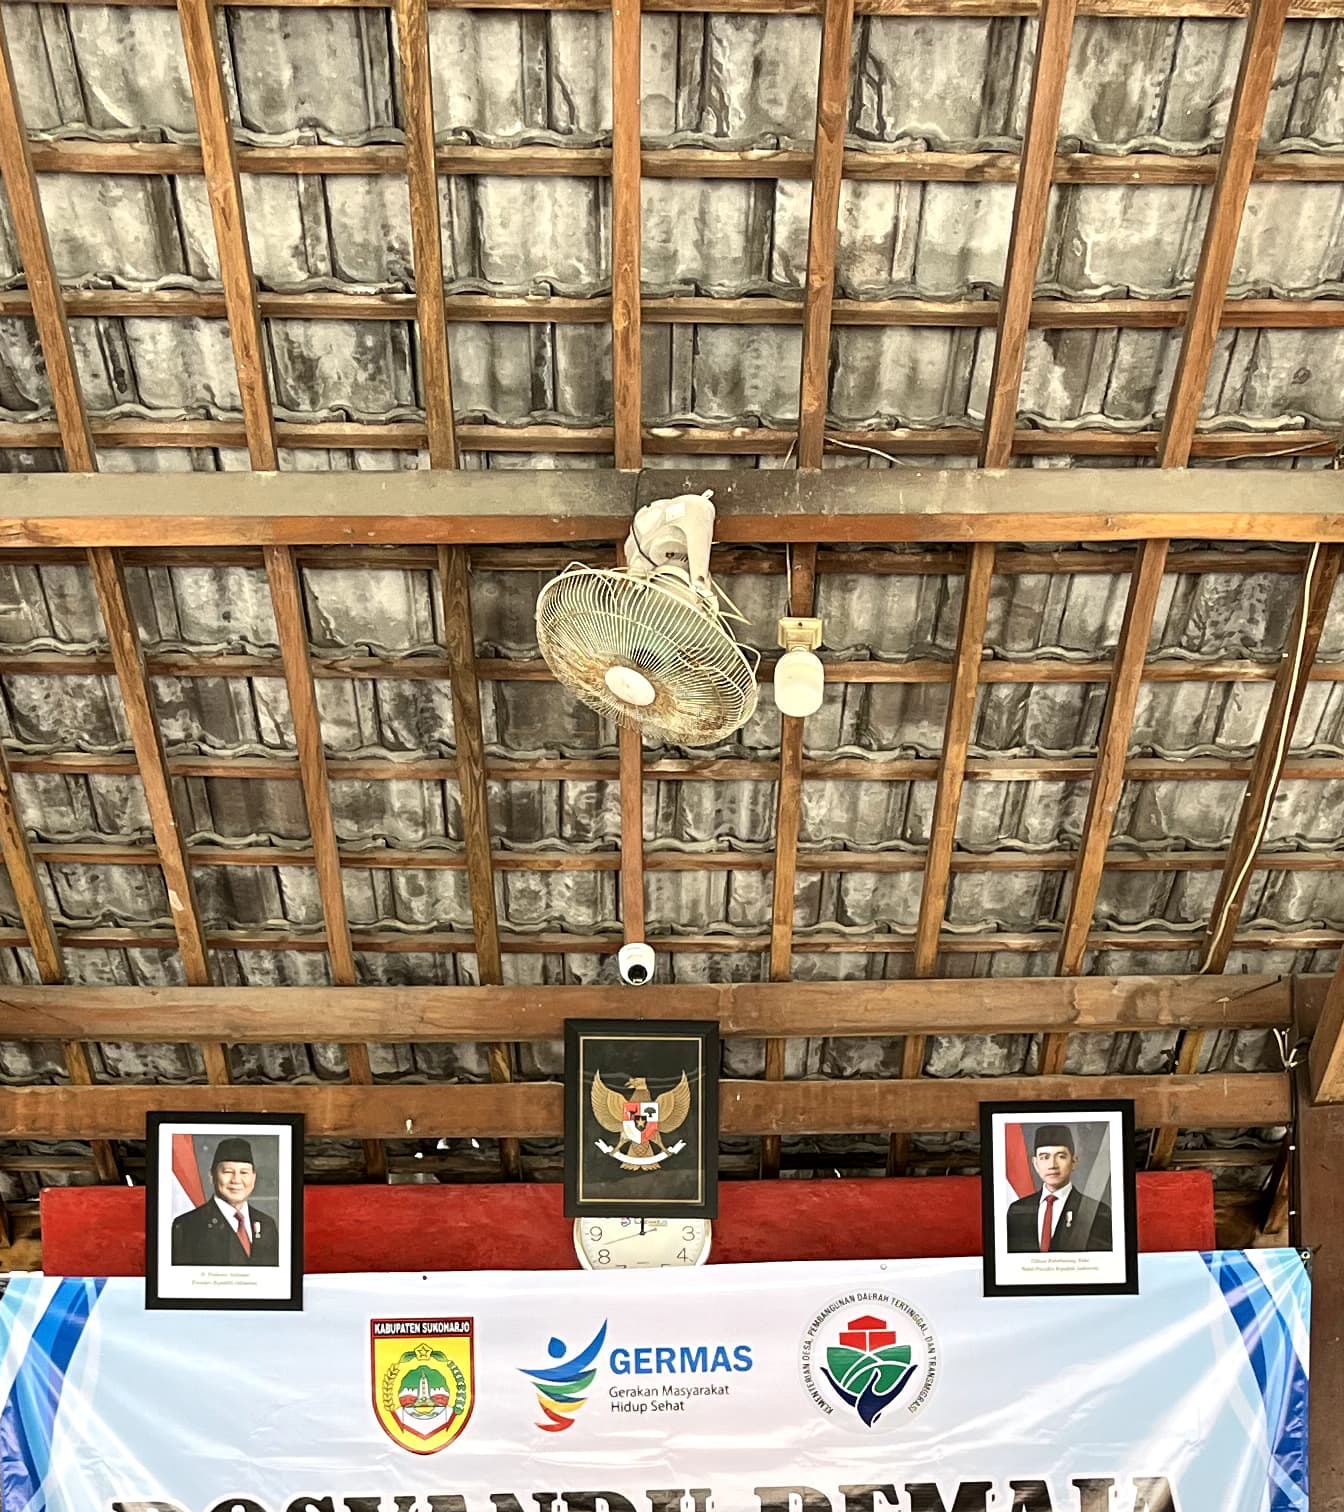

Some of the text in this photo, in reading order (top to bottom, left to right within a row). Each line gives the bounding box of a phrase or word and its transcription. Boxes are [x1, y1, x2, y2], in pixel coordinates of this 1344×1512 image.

[590, 1226, 603, 1242] 9
[682, 1225, 696, 1242] 3
[598, 1249, 611, 1265] 8
[677, 1247, 689, 1263] 4
[374, 1322, 421, 1335] KABUPATEN
[609, 1345, 754, 1375] GERMAS
[609, 1384, 730, 1399] Gerakan Masyarakat
[611, 1400, 685, 1414] Hidup Sehat
